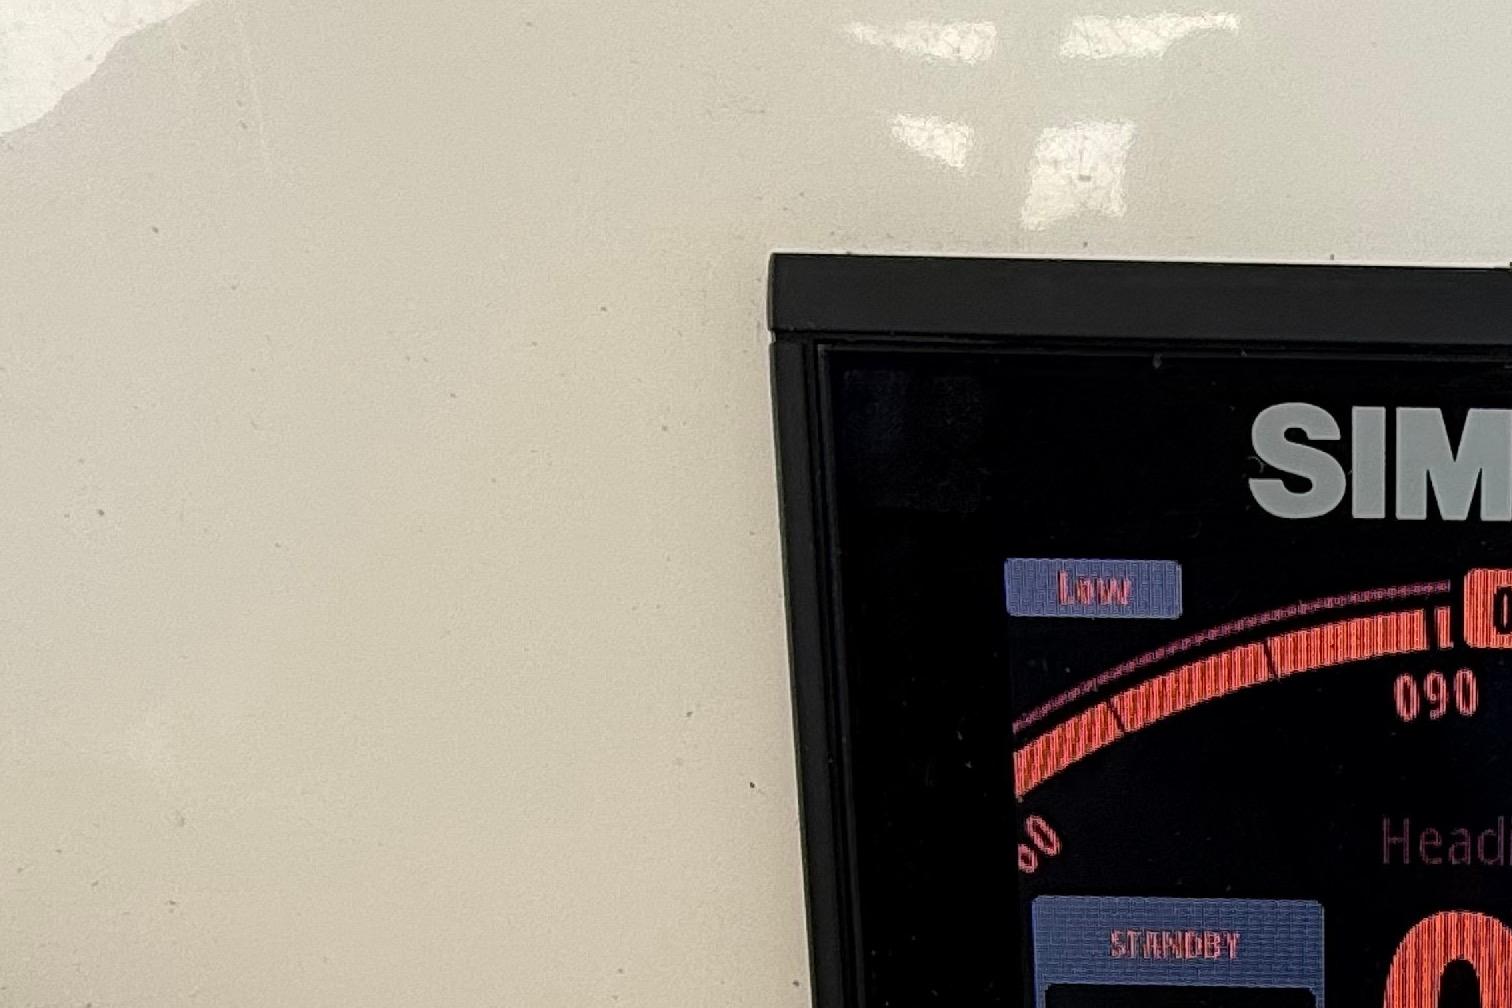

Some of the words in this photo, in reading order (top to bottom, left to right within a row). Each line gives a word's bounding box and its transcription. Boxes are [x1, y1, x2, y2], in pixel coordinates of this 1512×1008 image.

[1057, 569, 1133, 605] Low
[1394, 668, 1479, 722] 090
[1109, 928, 1241, 960] STANDBY
